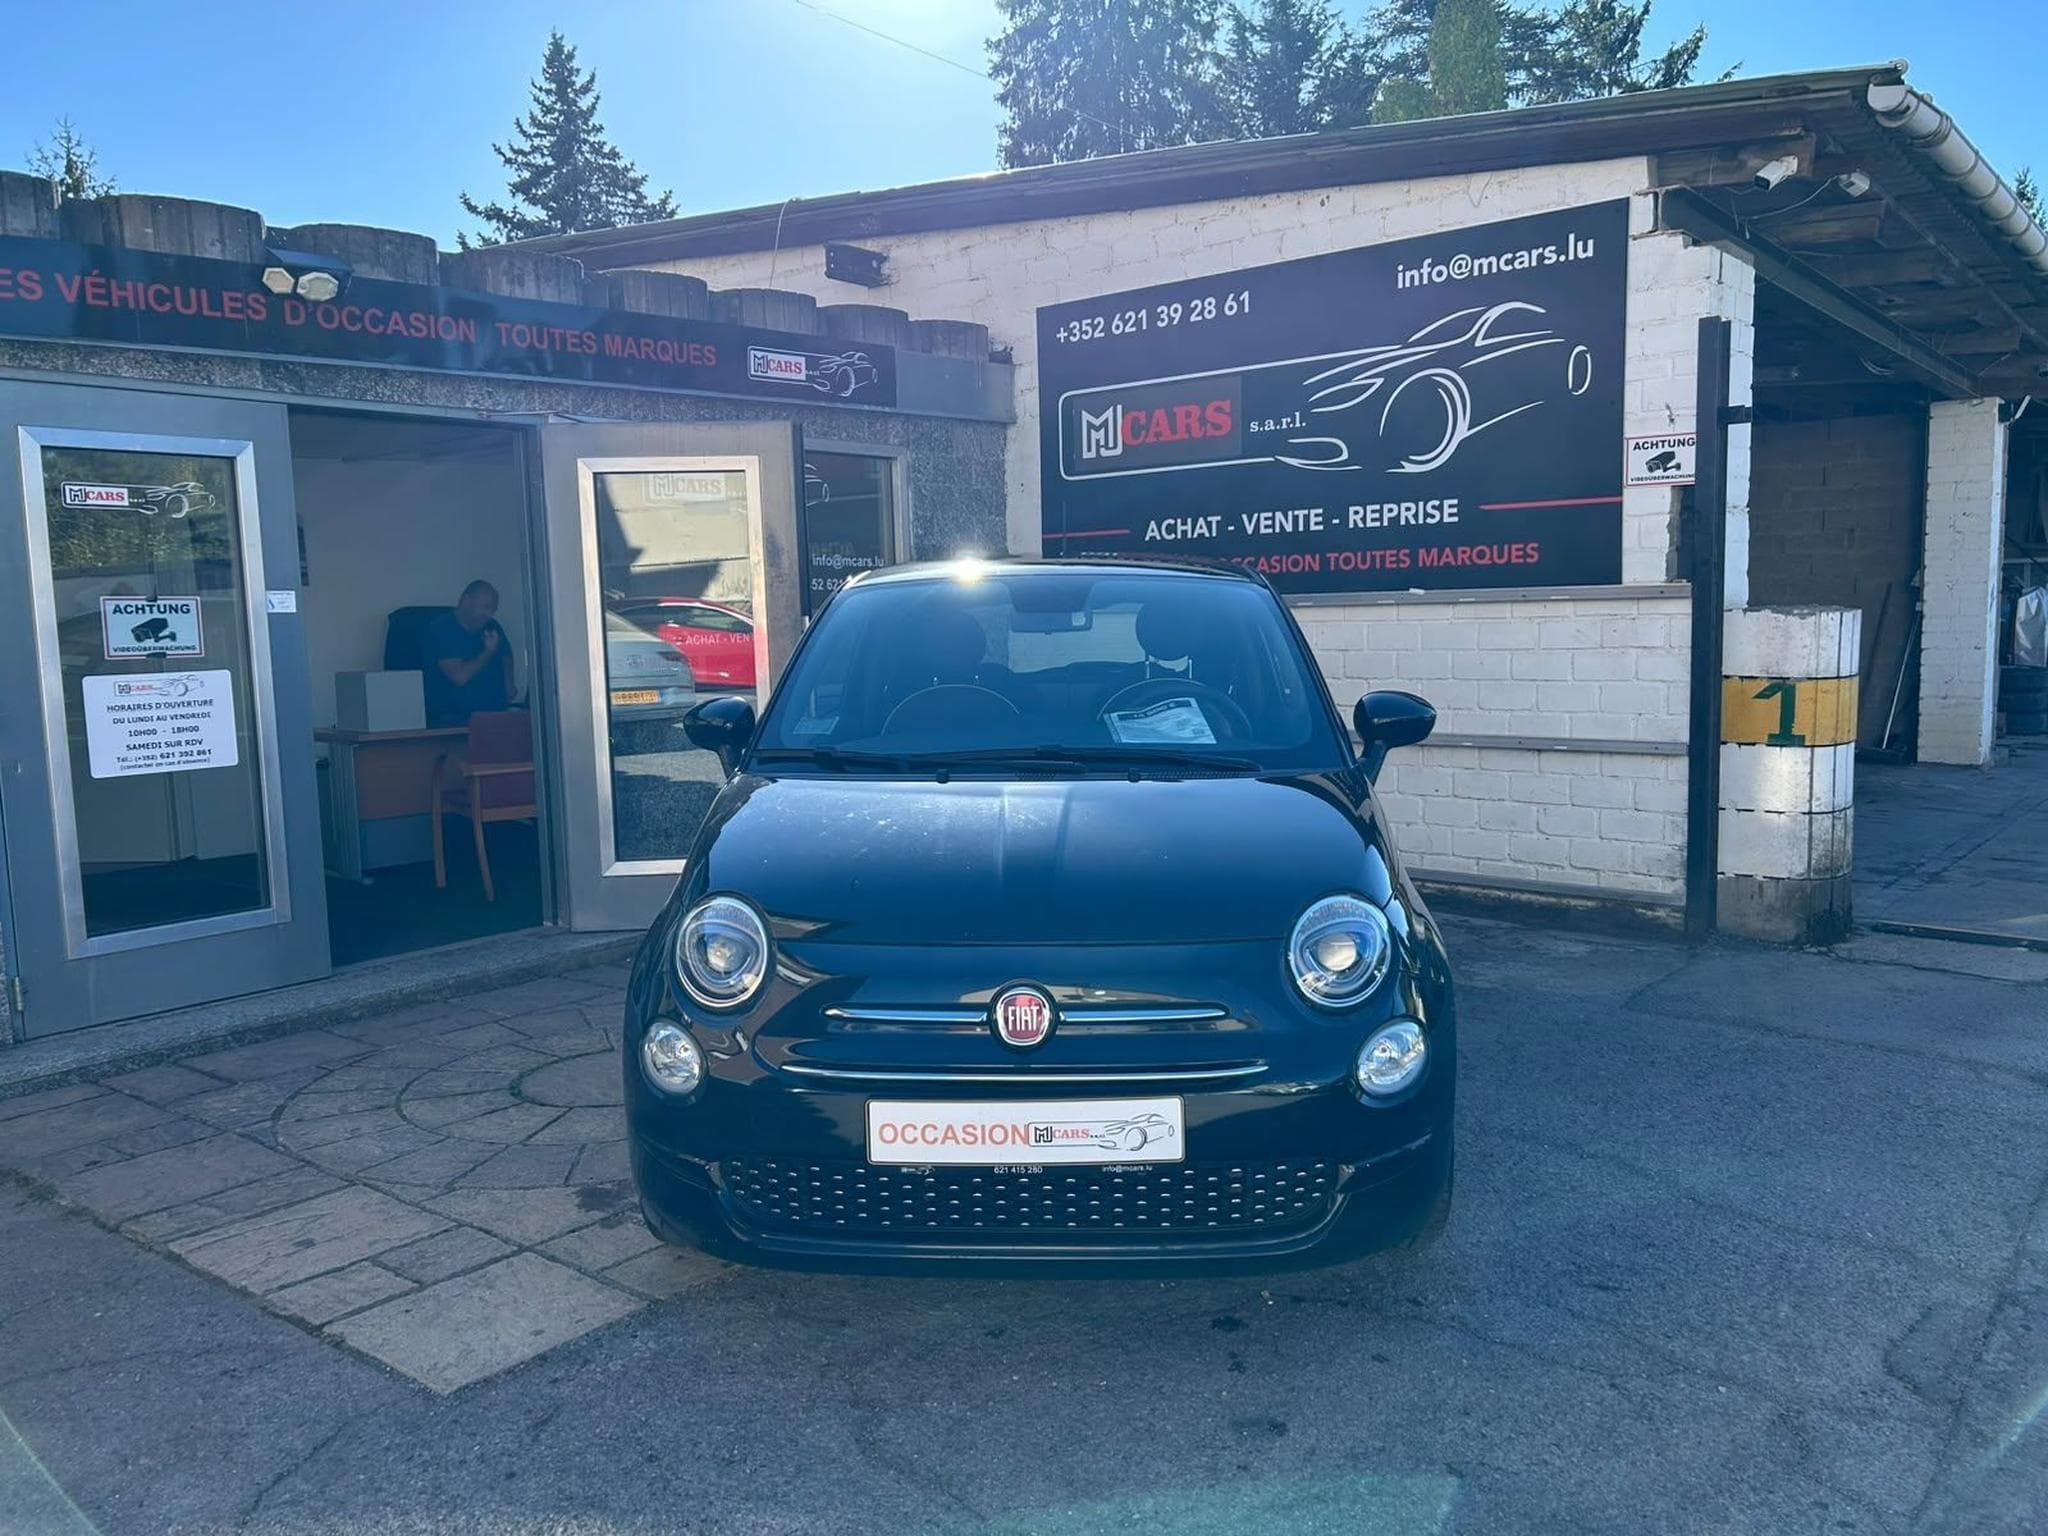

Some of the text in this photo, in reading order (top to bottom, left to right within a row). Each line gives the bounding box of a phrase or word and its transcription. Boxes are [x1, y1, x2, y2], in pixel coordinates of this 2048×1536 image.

[1397, 233, 1594, 289] info@mcars.lu
[54, 271, 267, 321] VÉHICULES
[284, 301, 476, 343] D'OCCASION
[495, 322, 597, 354] TOUTES
[604, 334, 717, 367] MARQUES
[1056, 291, 1250, 343] +352 621 39 28 61
[1250, 412, 1307, 432] s.a.r.l.
[1633, 437, 1696, 451] ACHTUNG
[1144, 516, 1222, 542] ACHAT
[1241, 508, 1325, 535] VENTE
[1348, 499, 1460, 529] REPRISE
[811, 553, 884, 569] info@mcars.lu
[1327, 549, 1411, 572] TOUTES
[1418, 542, 1540, 568] MARQUES
[112, 603, 191, 615] ACHTUNG
[685, 633, 720, 647] ACHAT
[107, 699, 214, 713] HORAIRES D'OUVERTURE
[1752, 682, 1806, 747] 1
[112, 711, 211, 725] DU LUNDI AU VENDREDI
[128, 728, 158, 737] 10H00
[171, 725, 200, 734] 18H00
[126, 738, 204, 751] SAMEDI SUR RDV
[1008, 1005, 1039, 1032] FIAT
[878, 1122, 1029, 1145] OCCASION
